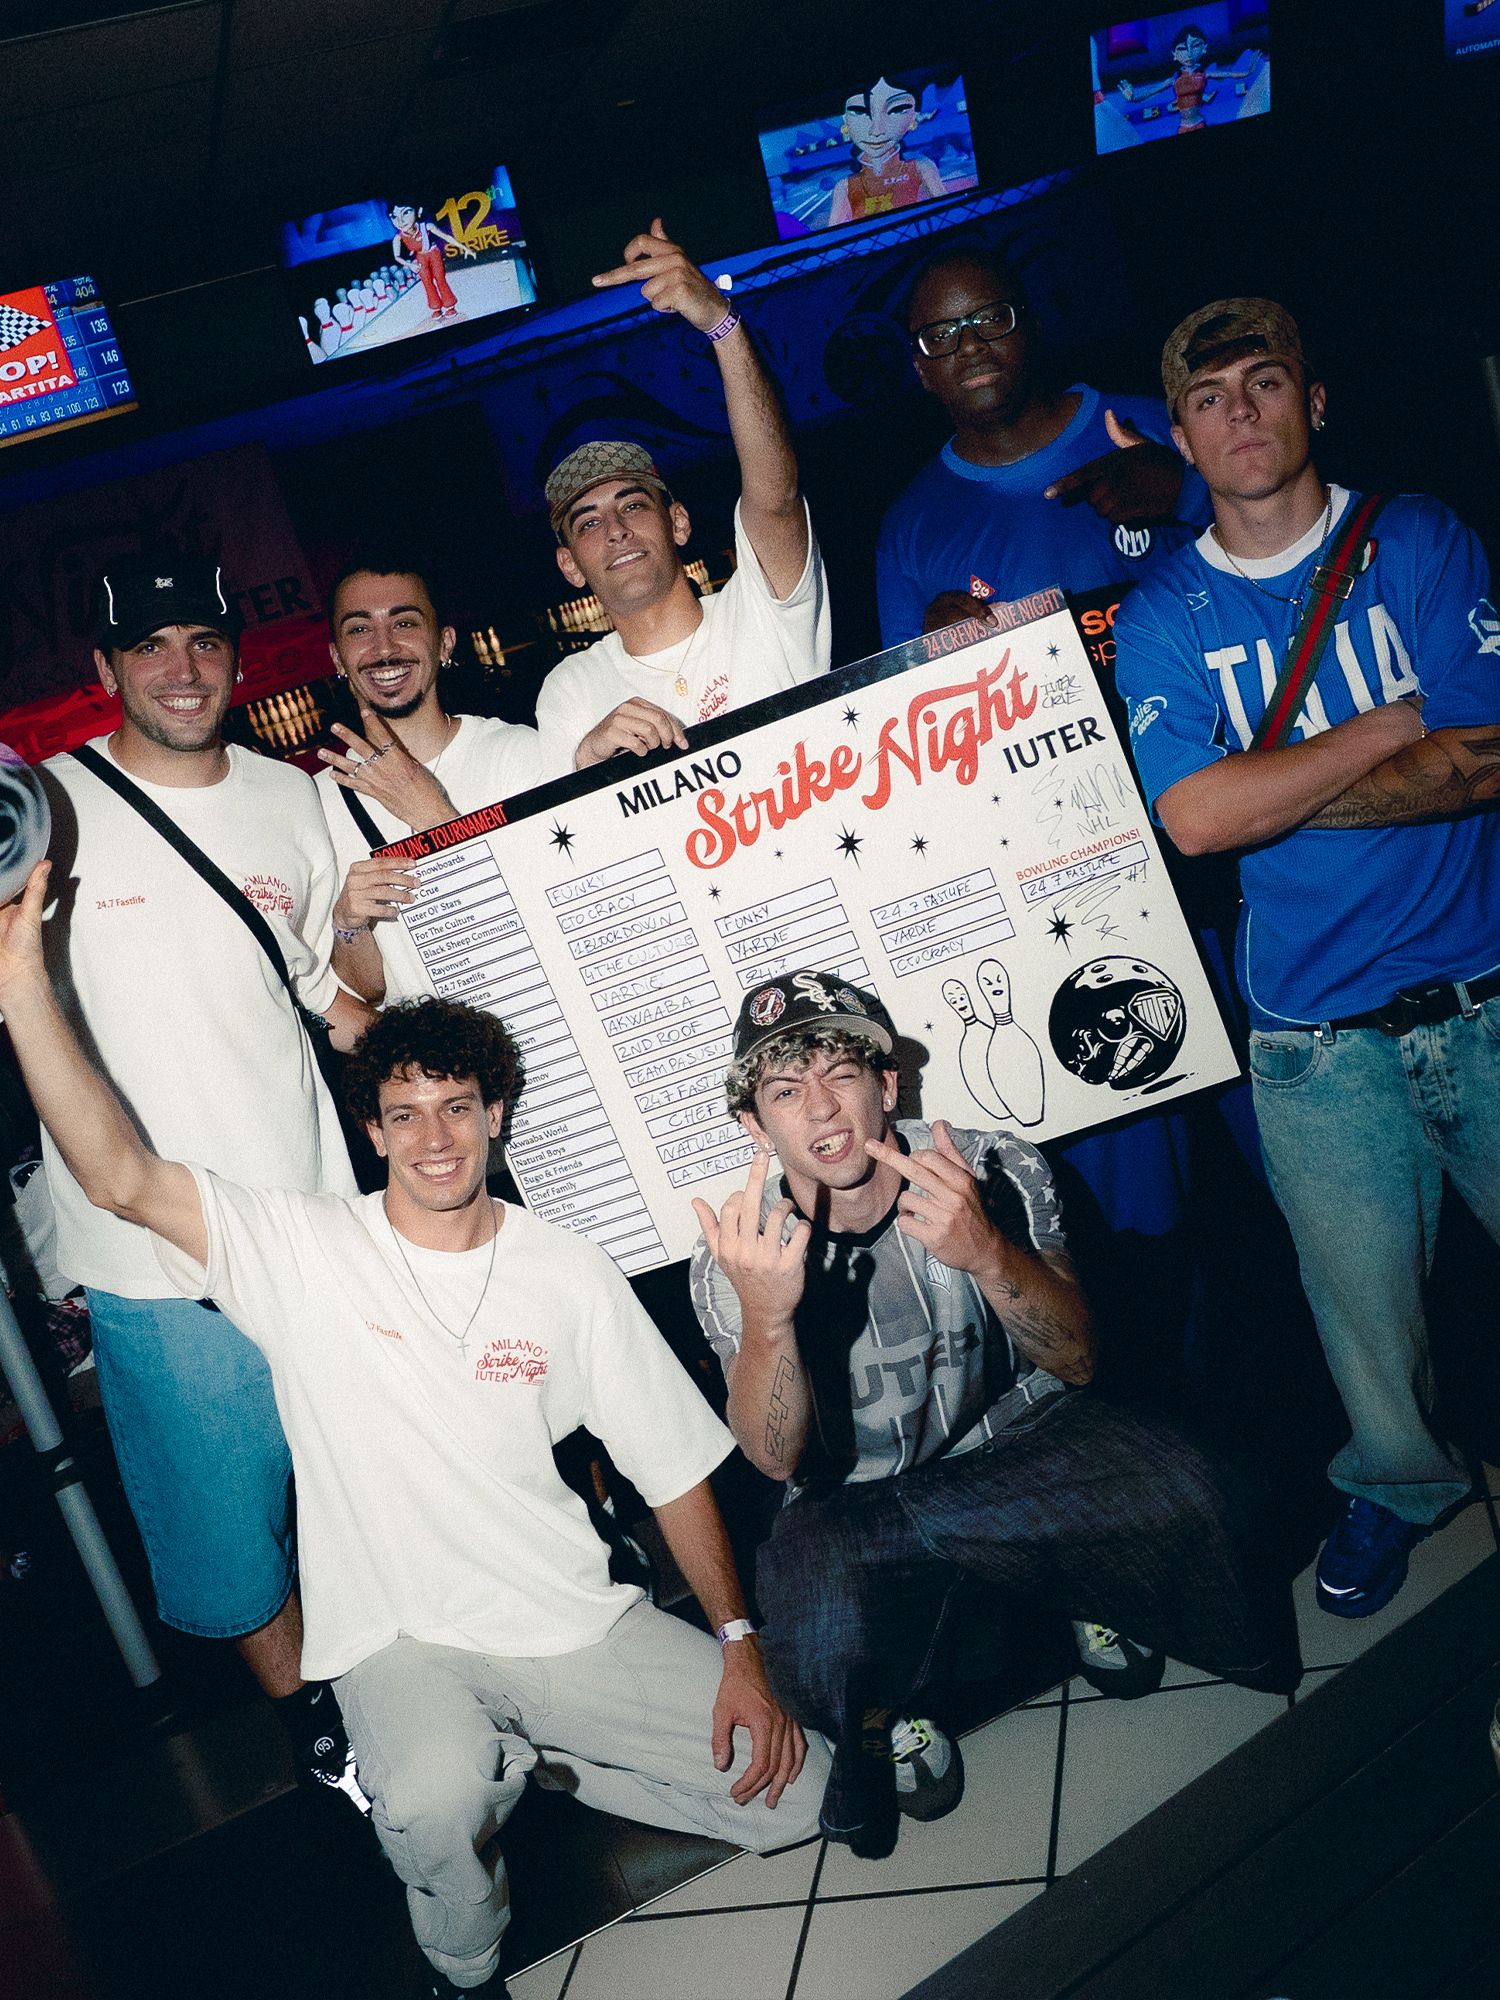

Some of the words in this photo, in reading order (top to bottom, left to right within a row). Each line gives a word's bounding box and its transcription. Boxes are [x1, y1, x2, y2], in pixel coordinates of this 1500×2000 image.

[436, 191, 500, 242] 12
[73, 276, 93, 285] TOTAL
[75, 285, 95, 299] 404
[90, 318, 108, 334] 135
[64, 336, 77, 348] 135
[101, 349, 119, 366] 146
[75, 366, 88, 379] 146
[112, 379, 130, 396] 123
[40, 409, 51, 423] 83
[54, 405, 65, 419] 92
[67, 400, 82, 416] 100
[84, 396, 99, 411] 123
[923, 638, 940, 660] 24
[1020, 588, 1062, 622] NIGHT
[700, 673, 729, 705] MILAN
[1002, 716, 1106, 774] IUTER
[685, 737, 862, 870] Strike
[862, 648, 1038, 811] Night
[616, 750, 742, 818] MILANO
[428, 803, 508, 850] TOURNAMENT
[415, 854, 466, 878] Snowboards
[1016, 854, 1070, 881] BOWLING
[1069, 828, 1142, 865] CHAMPIONS!
[248, 875, 288, 893] MILANO
[420, 885, 440, 899] Crue
[552, 874, 607, 903] FUNKY
[96, 899, 115, 910] 24.7
[116, 896, 146, 906] Fastlife
[441, 897, 463, 912] Stars
[415, 931, 429, 942] For
[428, 925, 444, 937] The
[444, 913, 476, 929] Culture
[423, 944, 446, 959] Black
[445, 936, 472, 952] Sheep
[471, 918, 519, 941] Community
[888, 918, 938, 945] YARDIE
[732, 927, 791, 959] YARDIE
[430, 956, 472, 977] Rayonvert
[438, 981, 458, 995] 24.7
[457, 970, 487, 988] Fastlife
[608, 996, 695, 1034] AKWAABA
[618, 1039, 653, 1060] 2ND
[656, 1021, 703, 1046] ROOF
[625, 1063, 666, 1084] TEAM
[668, 1102, 719, 1127] CHEF
[509, 1133, 544, 1151] Akwaaba
[543, 1124, 569, 1140] World
[662, 1124, 734, 1159] NATURAL
[515, 1151, 547, 1168] Natural
[547, 1146, 567, 1159] Boys
[523, 1172, 545, 1187] Sugo
[553, 1159, 583, 1176] Friends
[672, 1169, 693, 1184] LA
[531, 1188, 551, 1203] Chef
[550, 1181, 578, 1197] Family
[538, 1205, 562, 1219] Fritto
[562, 1201, 576, 1213] Fm
[572, 1214, 598, 1228] Clown
[491, 1338, 544, 1358] MILANO
[475, 1370, 509, 1383] IUTER
[510, 1359, 549, 1382] Night
[476, 1352, 520, 1370] Strike
[850, 1327, 980, 1410] UTER
[318, 1740, 331, 1753] 95
